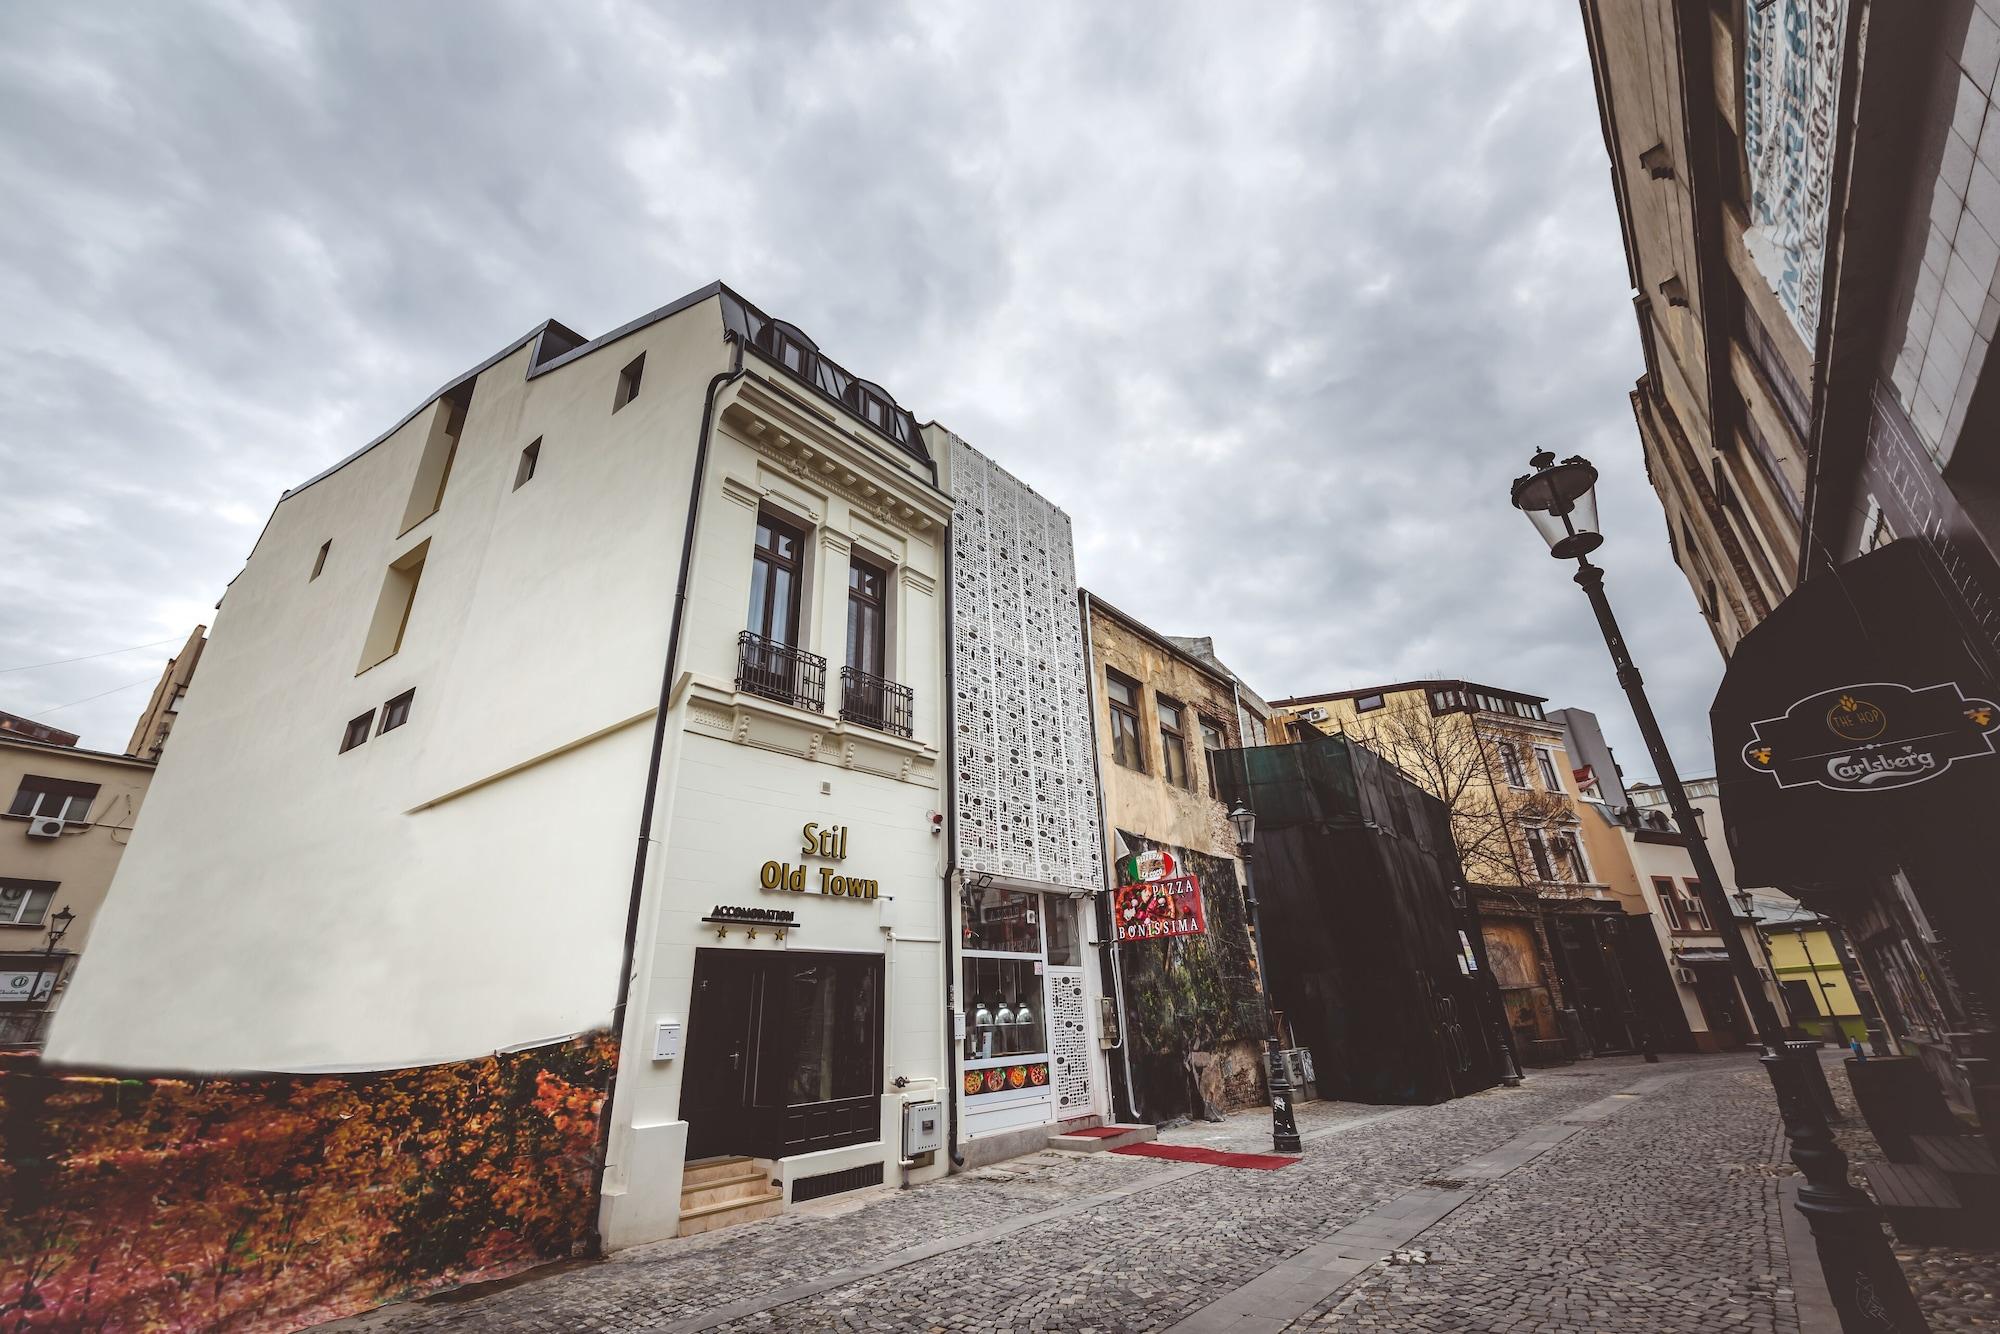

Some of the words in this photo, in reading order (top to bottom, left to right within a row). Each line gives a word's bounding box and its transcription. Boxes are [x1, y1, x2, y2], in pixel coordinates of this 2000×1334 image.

[1834, 713, 1854, 729] THE
[1858, 709, 1880, 724] HOP
[1827, 751, 1936, 785] Carlsberg
[802, 822, 848, 860] Stil
[761, 860, 807, 892] Old
[819, 867, 879, 900] Town
[1151, 879, 1194, 897] PIZZA
[1118, 917, 1199, 939] BONISSIMA
